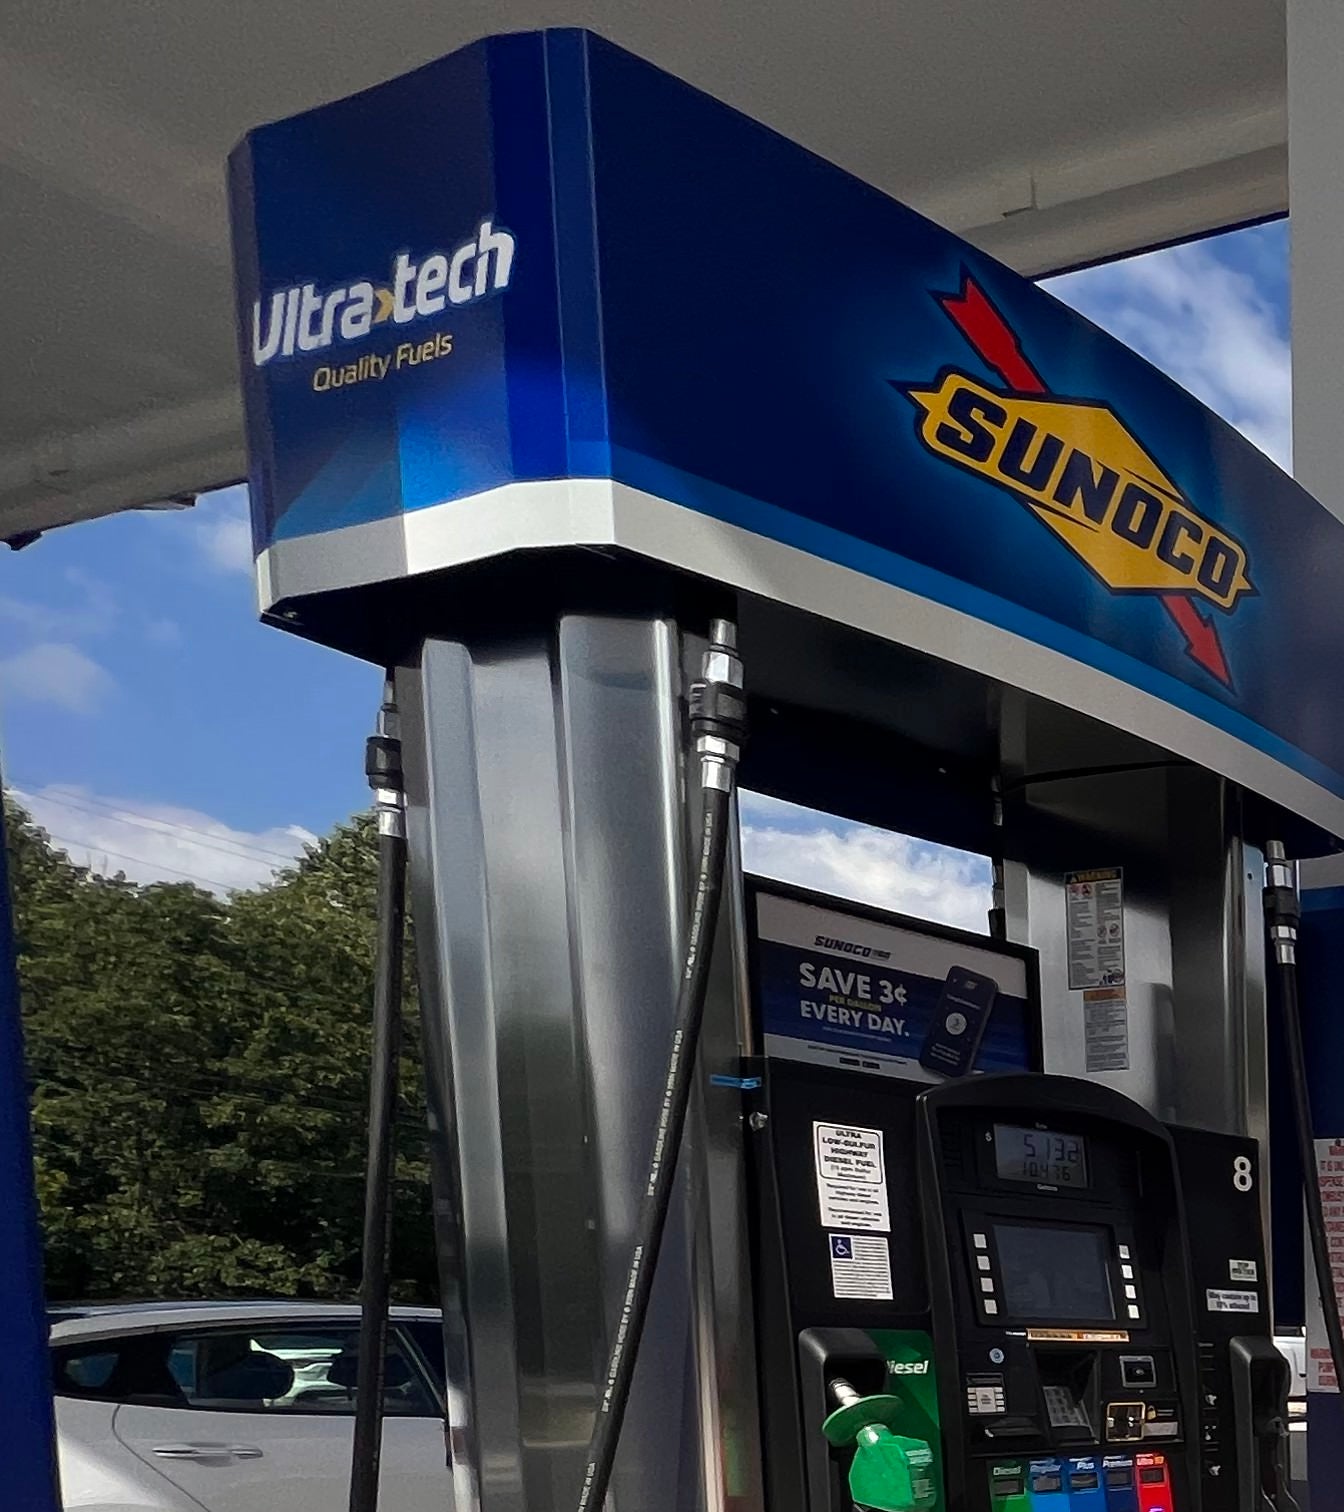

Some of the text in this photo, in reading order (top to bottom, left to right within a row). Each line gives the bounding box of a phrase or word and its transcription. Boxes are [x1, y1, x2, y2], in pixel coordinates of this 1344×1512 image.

[313, 331, 453, 393] Quality Fuels
[935, 386, 1240, 599] SUNOCO
[814, 935, 872, 957] SUNOCO
[799, 962, 872, 1000] SAVE
[800, 1000, 863, 1029] EVERY
[868, 1013, 911, 1038] DAY.
[1233, 1156, 1253, 1192] 8
[887, 1360, 929, 1375] iesel
